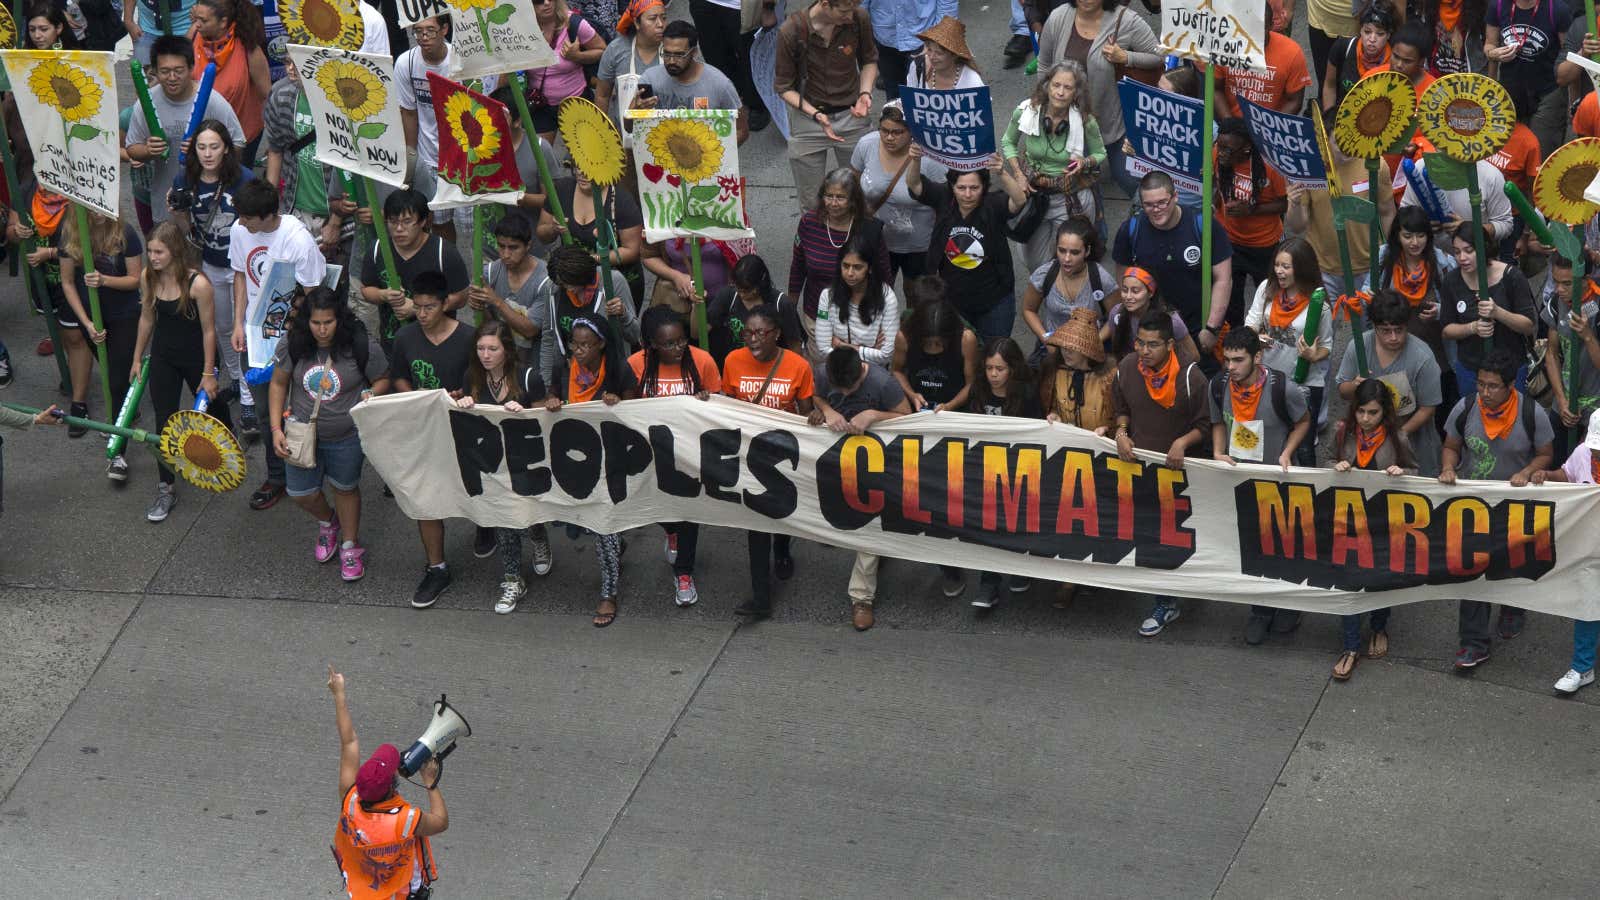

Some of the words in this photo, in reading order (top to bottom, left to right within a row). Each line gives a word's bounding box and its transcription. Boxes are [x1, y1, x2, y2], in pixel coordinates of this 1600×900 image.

[300, 48, 333, 80] CLIMATE
[341, 50, 391, 83] JUSTICE
[1235, 77, 1265, 92] YOUTH
[914, 92, 978, 111] DON'T
[1247, 90, 1274, 103] FORCE
[1353, 88, 1374, 108] OUR
[1448, 81, 1481, 96] THE
[1481, 89, 1508, 134] POWER
[912, 108, 985, 129] FRACK
[1138, 91, 1196, 126] DON'T
[1249, 104, 1304, 136] DON'T
[1135, 110, 1200, 147] FRACK
[1250, 120, 1315, 155] FRACK
[922, 131, 977, 154] U.S.!
[366, 145, 398, 166] NOW
[1142, 137, 1190, 172] U.S.!
[740, 380, 791, 396] ROCAWAY
[747, 393, 780, 408] YUTH
[450, 409, 799, 519] PEOPLES
[822, 433, 1196, 562] CLIMATE
[1242, 479, 1555, 586] MARCH
